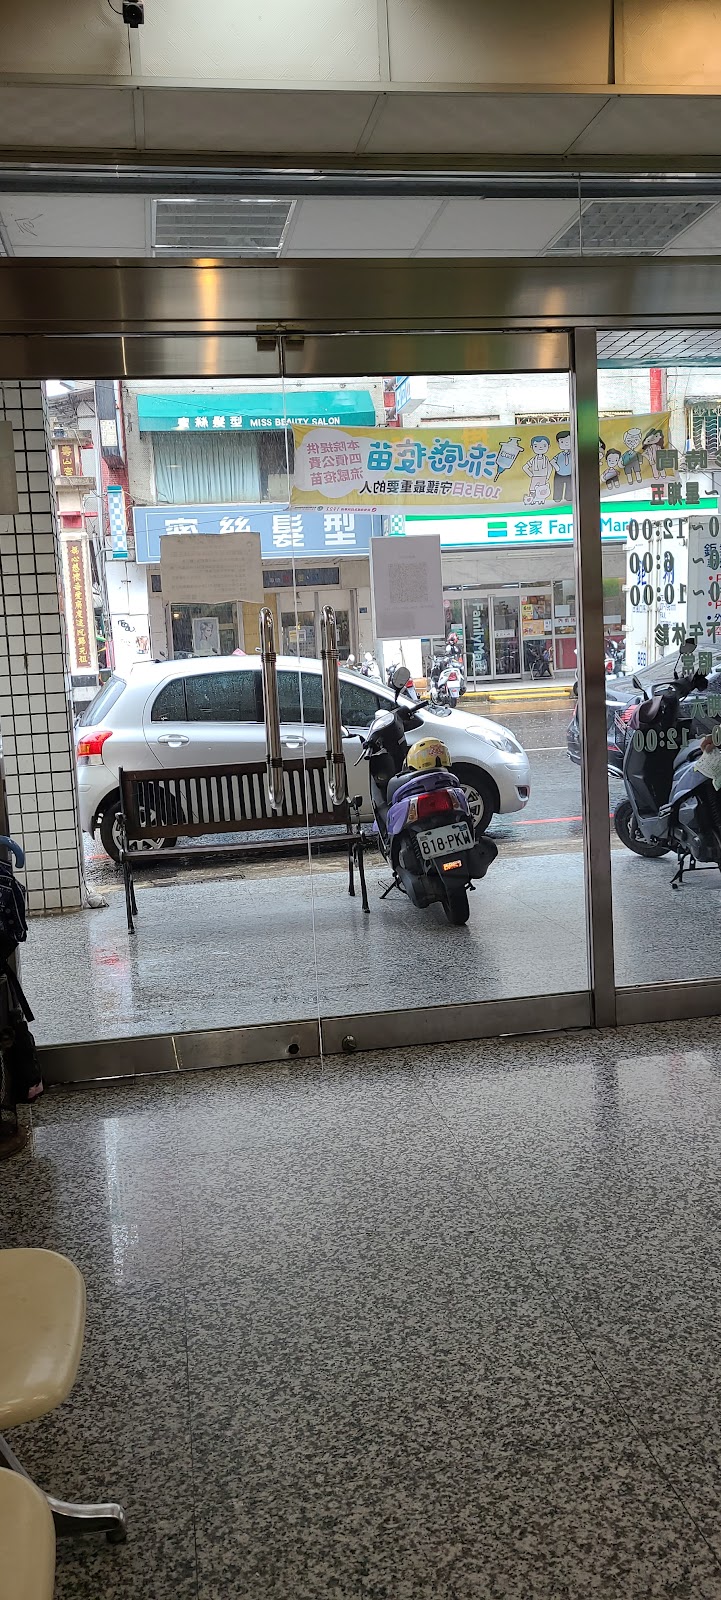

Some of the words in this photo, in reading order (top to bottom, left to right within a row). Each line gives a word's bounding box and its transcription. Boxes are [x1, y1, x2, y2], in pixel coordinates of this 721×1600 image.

[250, 418, 272, 427] MISS
[275, 417, 309, 427] BEAUTY
[311, 417, 340, 425] SALON
[514, 521, 543, 536] 全家
[470, 603, 485, 671] FamilyMart
[421, 831, 472, 855] 818-PKW
